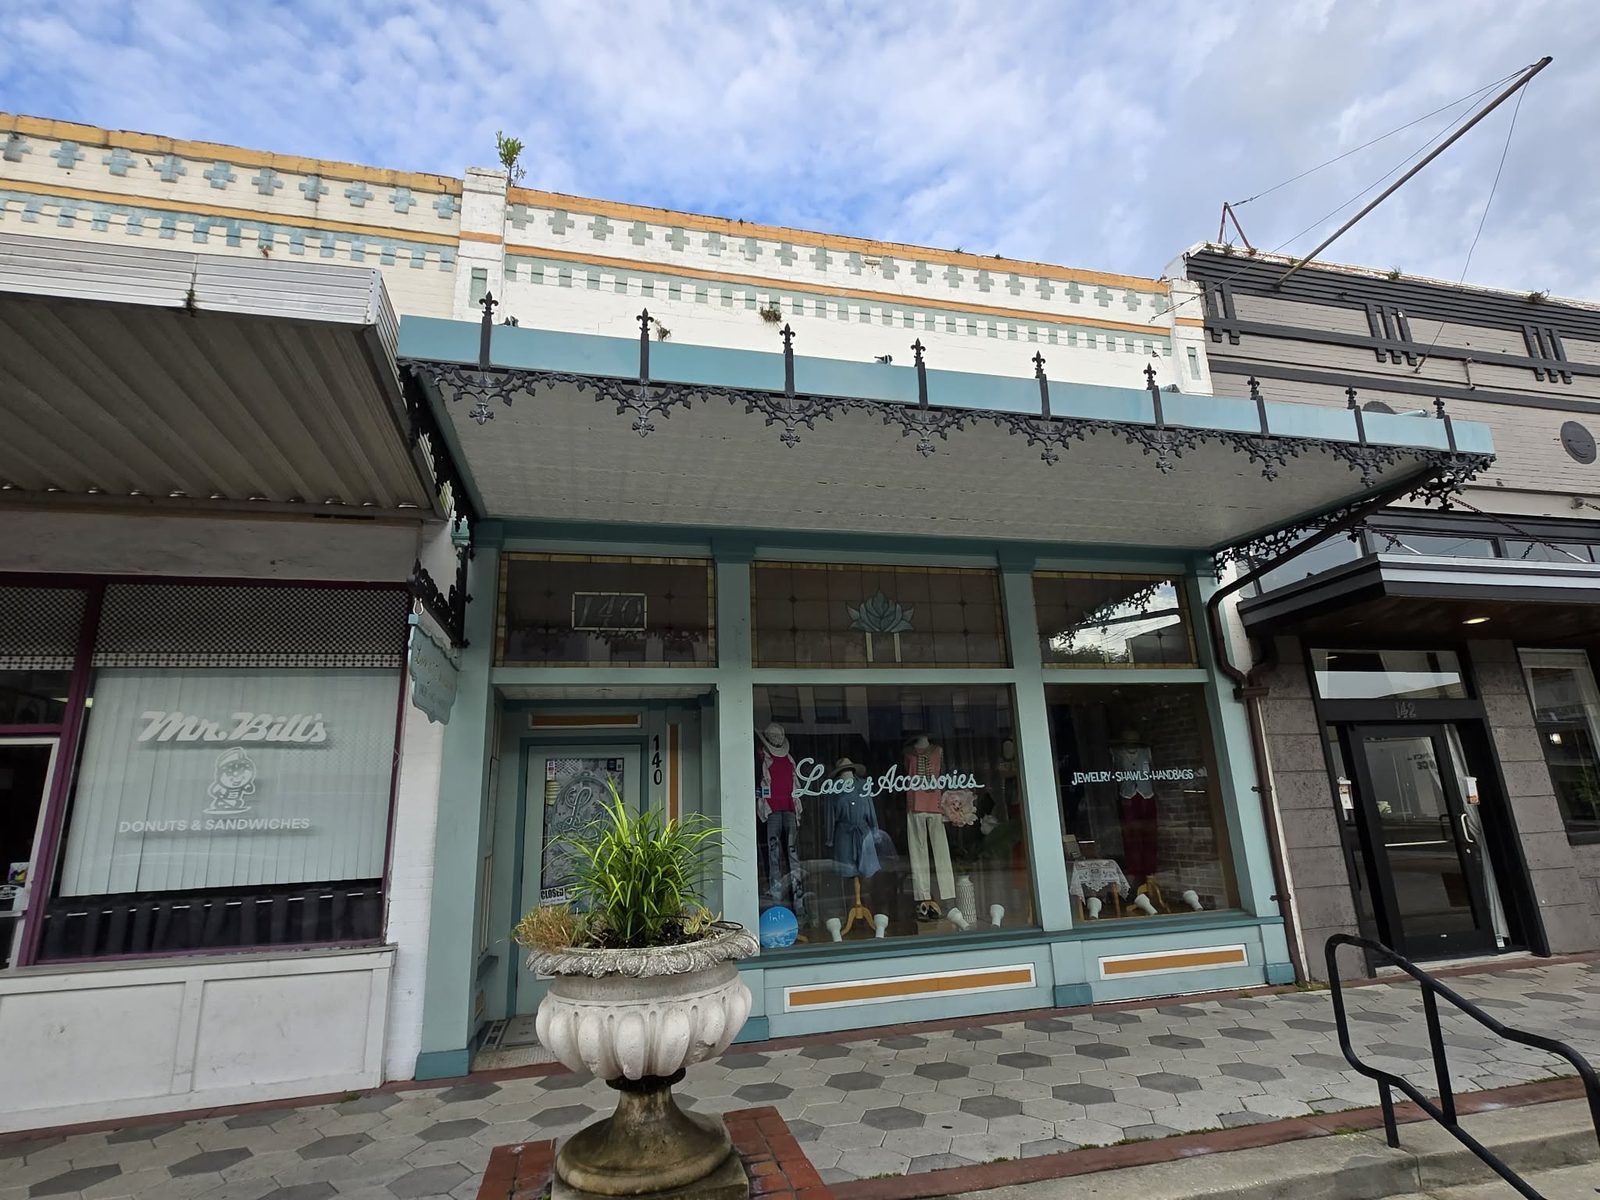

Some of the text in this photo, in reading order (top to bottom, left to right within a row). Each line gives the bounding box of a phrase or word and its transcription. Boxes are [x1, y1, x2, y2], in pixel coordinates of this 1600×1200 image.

[137, 711, 327, 742] Mr. Bill's
[792, 757, 855, 798] Lace
[870, 764, 985, 798] Accessories
[1071, 769, 1194, 786] JEWELRY SHAWLS HANDBAGS
[119, 818, 311, 833] DONUTS & SANDWICHES
[540, 888, 564, 900] CLOSED
